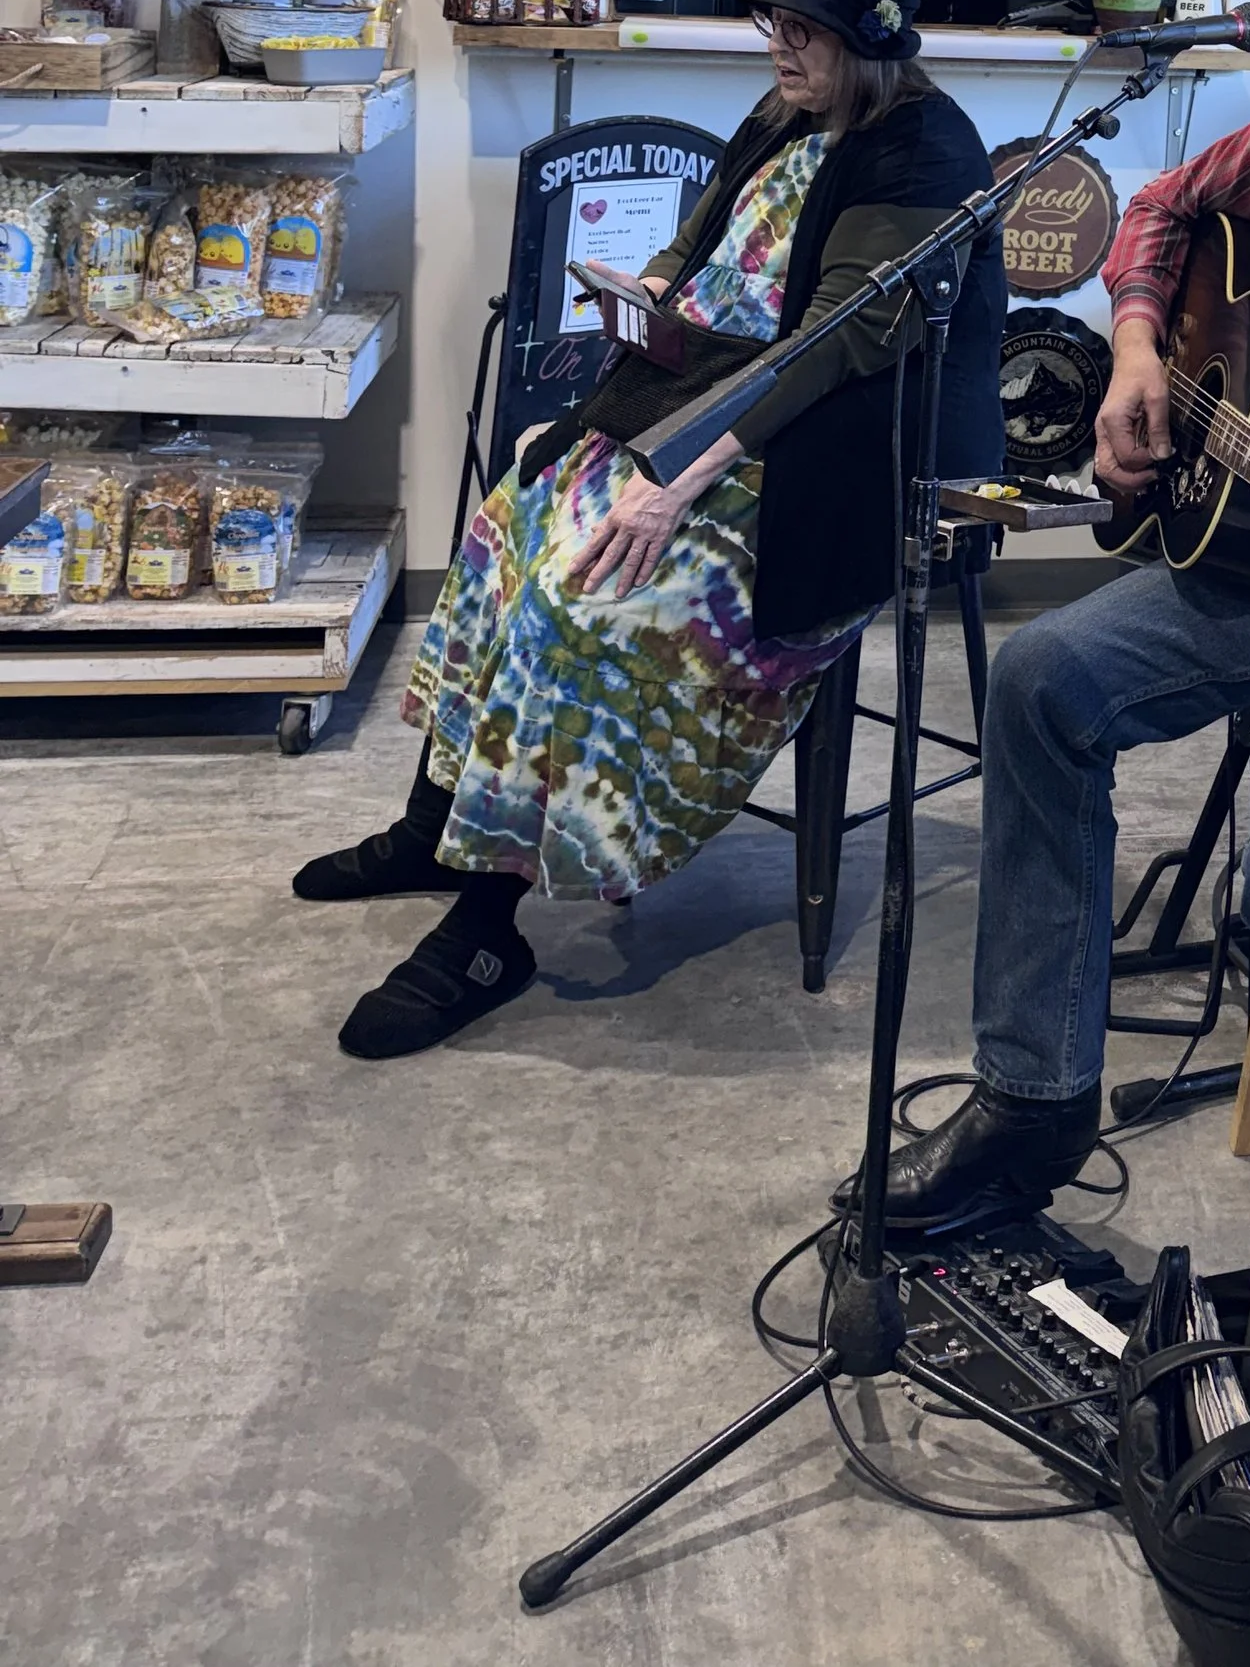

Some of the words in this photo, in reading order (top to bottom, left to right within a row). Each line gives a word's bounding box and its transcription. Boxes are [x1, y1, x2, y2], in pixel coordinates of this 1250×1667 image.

[1180, 2, 1205, 12] BEER
[539, 144, 636, 193] SPECIAL
[642, 144, 715, 185] TODAY
[1003, 228, 1077, 253] ROOT
[1003, 250, 1073, 274] BEER
[1003, 337, 1066, 357] MOUNTAIN
[1068, 347, 1091, 375] SODA
[1088, 378, 1098, 396] CO
[1007, 442, 1043, 456] ATURAL
[1047, 439, 1072, 455] SODA
[1073, 422, 1088, 440] POP
